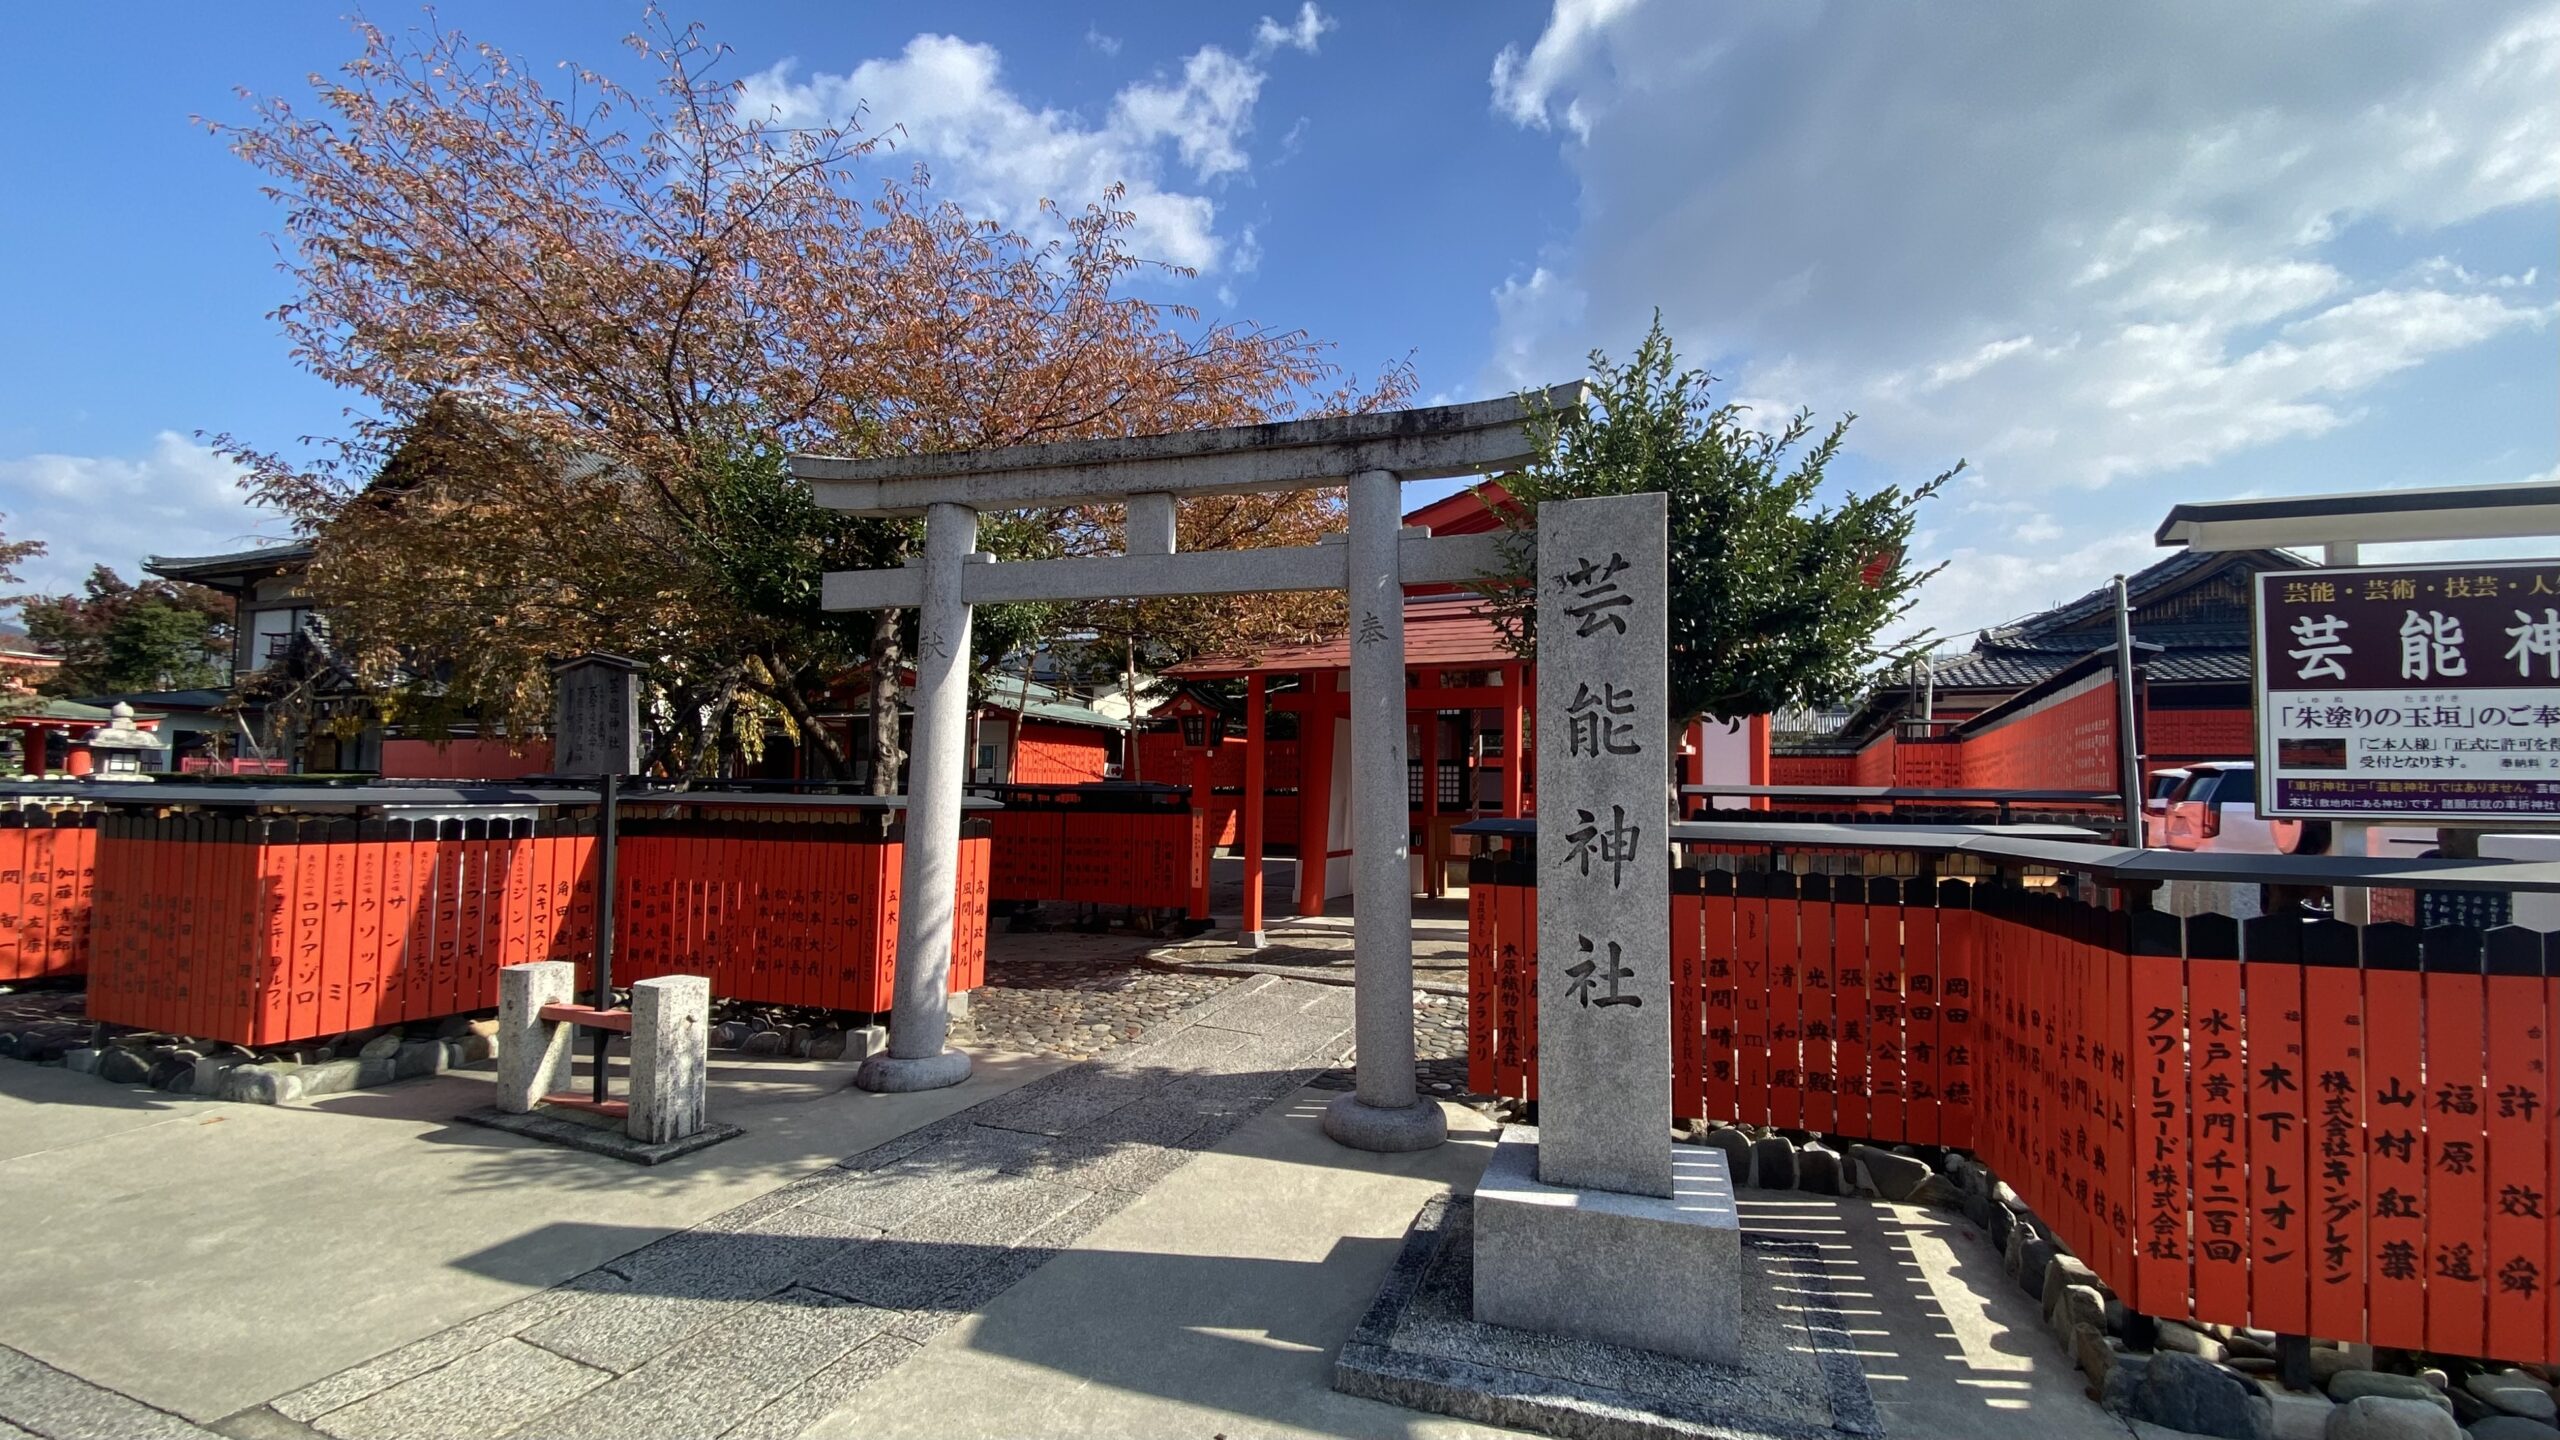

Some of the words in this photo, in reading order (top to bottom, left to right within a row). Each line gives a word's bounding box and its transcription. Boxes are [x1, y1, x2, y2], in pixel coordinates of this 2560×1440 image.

[1357, 611, 1389, 650] 奉
[1564, 552, 1643, 1010] 芸能神社
[2359, 755, 2467, 769] 受付となります。
[328, 899, 349, 1001] ナミ
[355, 897, 376, 995] ウソップ
[386, 894, 407, 993] サンジ
[438, 891, 455, 986] ニコ・ロビン
[463, 888, 482, 980] フランキー
[485, 887, 506, 978] ブルック
[508, 886, 528, 967] ジンベ
[884, 889, 898, 983] 五木ひろし
[1742, 960, 1764, 1087] Yumi
[2146, 1006, 2184, 1261] タワーレコード株式会社
[2199, 1008, 2243, 1265] 水戸黄門千二百回
[2257, 1062, 2298, 1265] 木下レオン
[2318, 1070, 2361, 1286] 株式会社キングレオン
[2372, 1076, 2422, 1282] 山村紅葉
